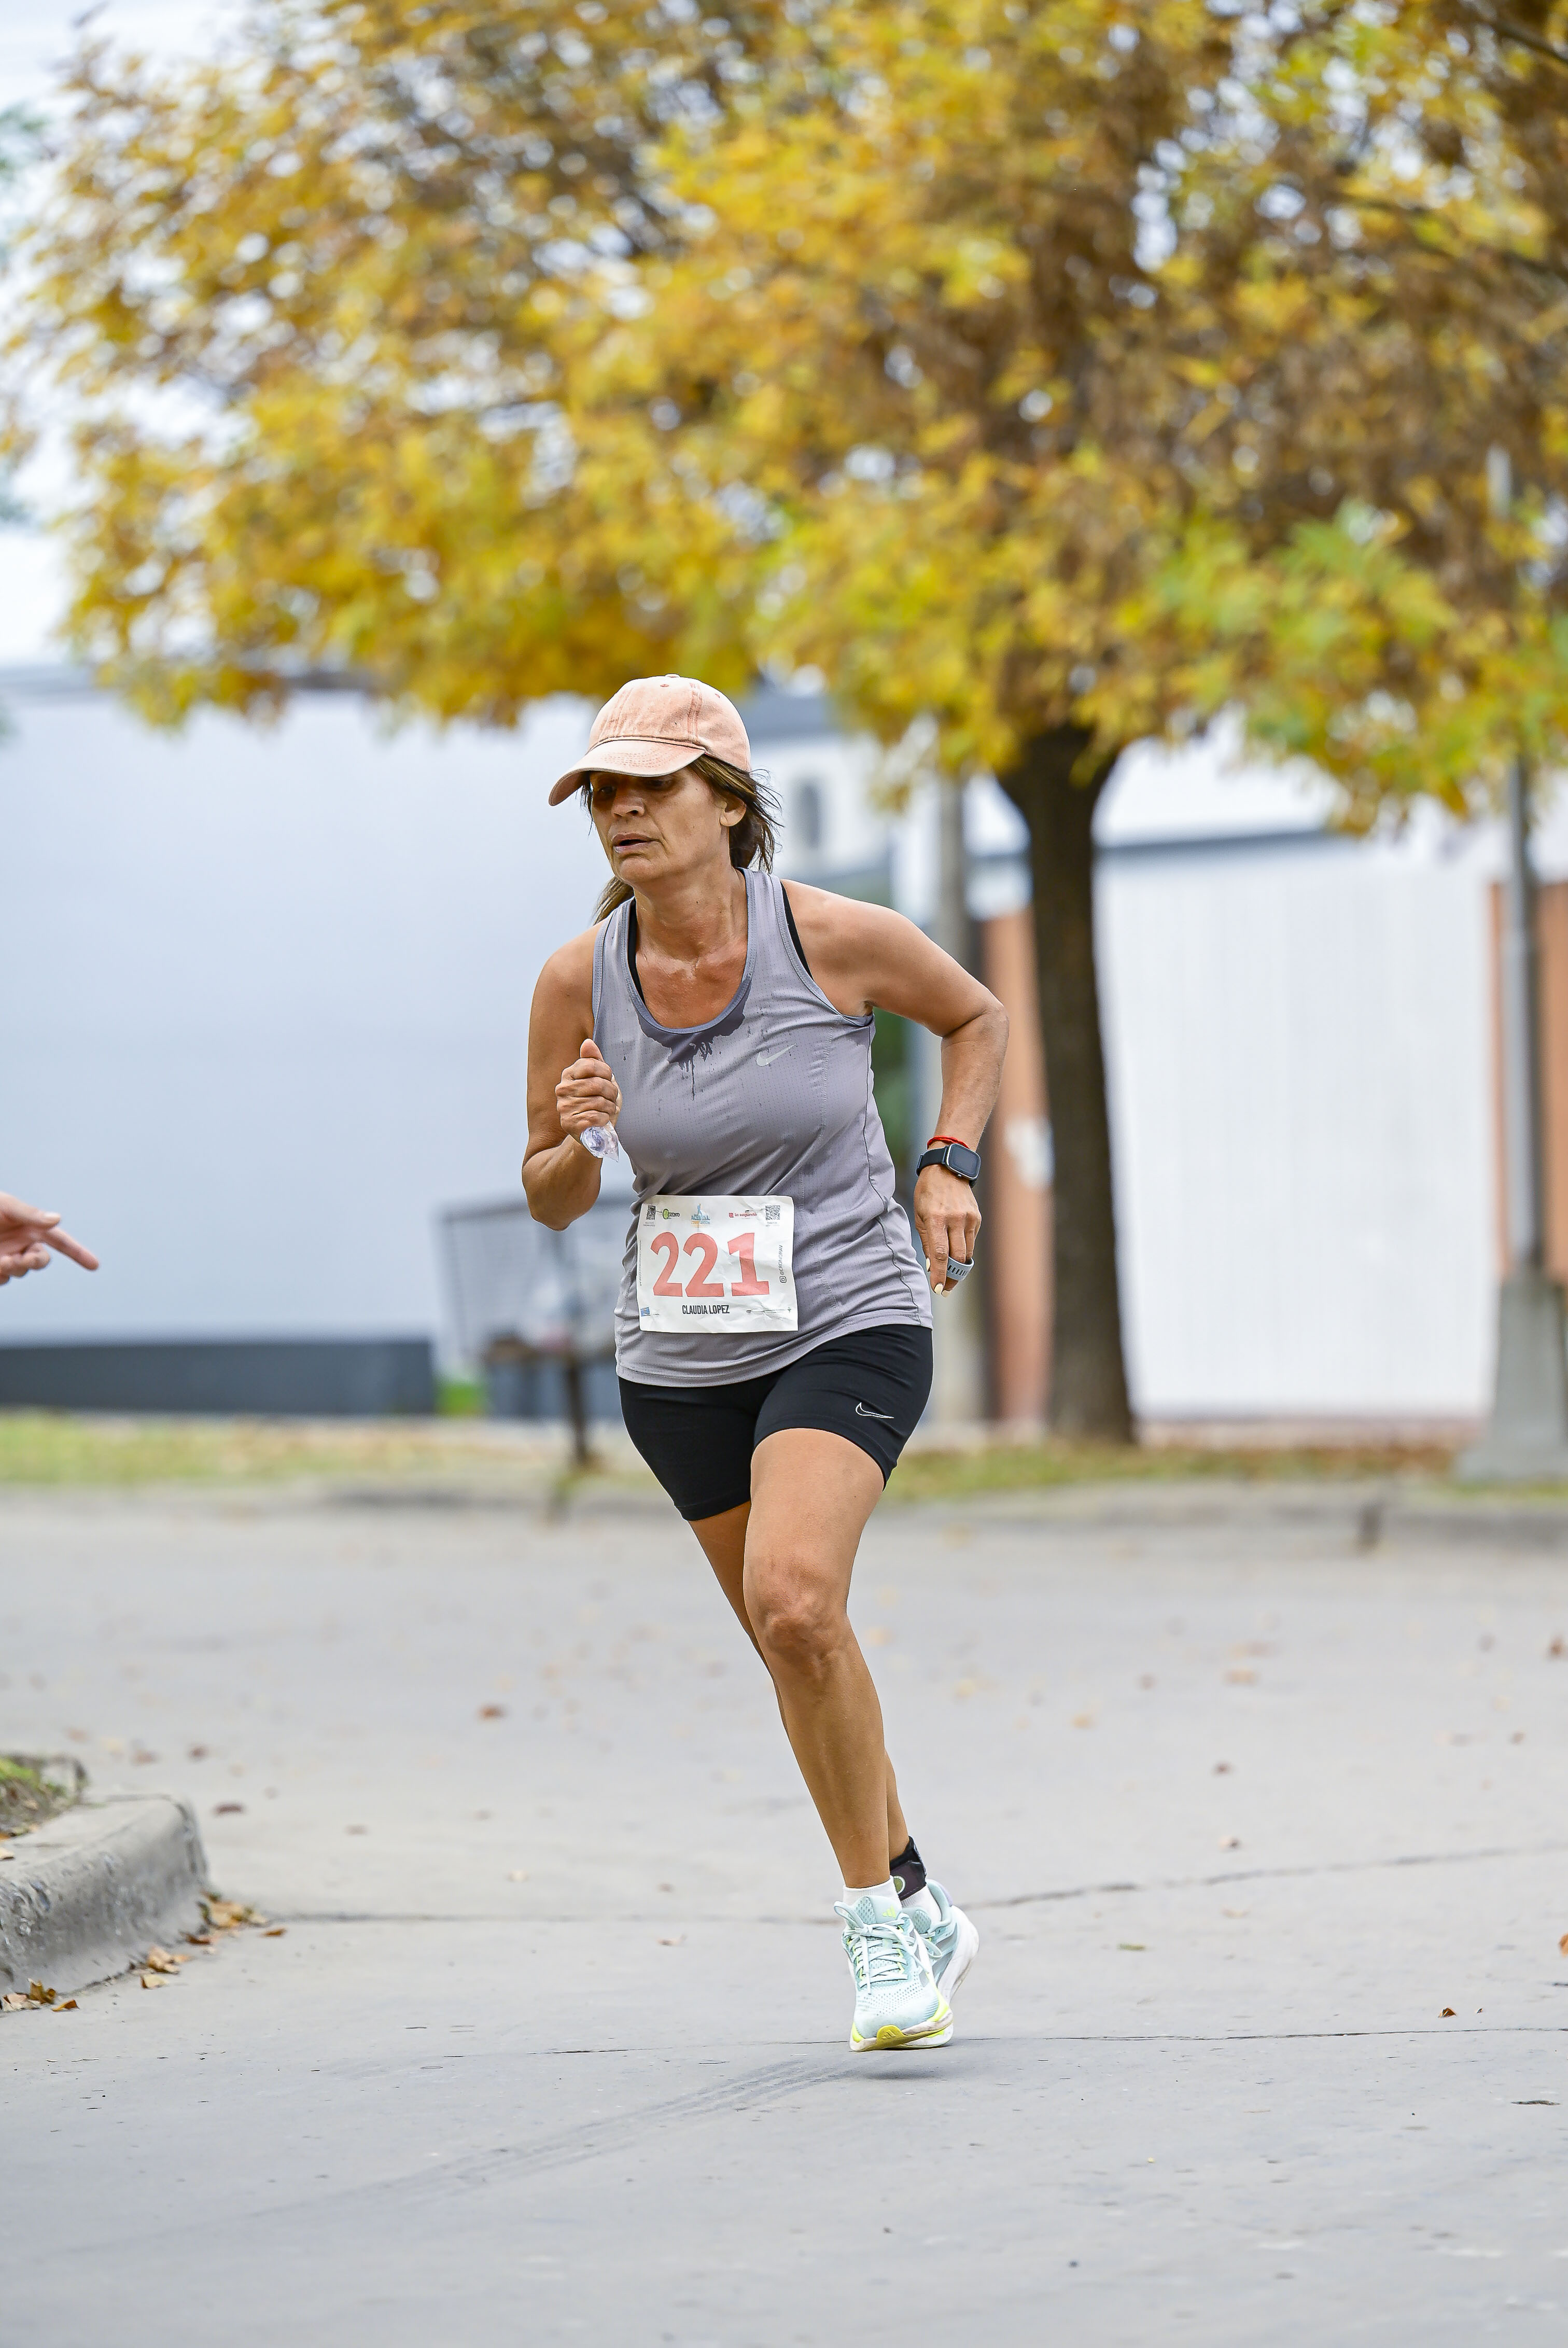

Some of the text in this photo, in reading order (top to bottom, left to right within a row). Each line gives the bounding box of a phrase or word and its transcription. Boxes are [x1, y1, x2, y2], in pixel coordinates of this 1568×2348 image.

[651, 1232, 769, 1297] 221
[682, 1305, 730, 1315] CLAUDIA LOPEZ
